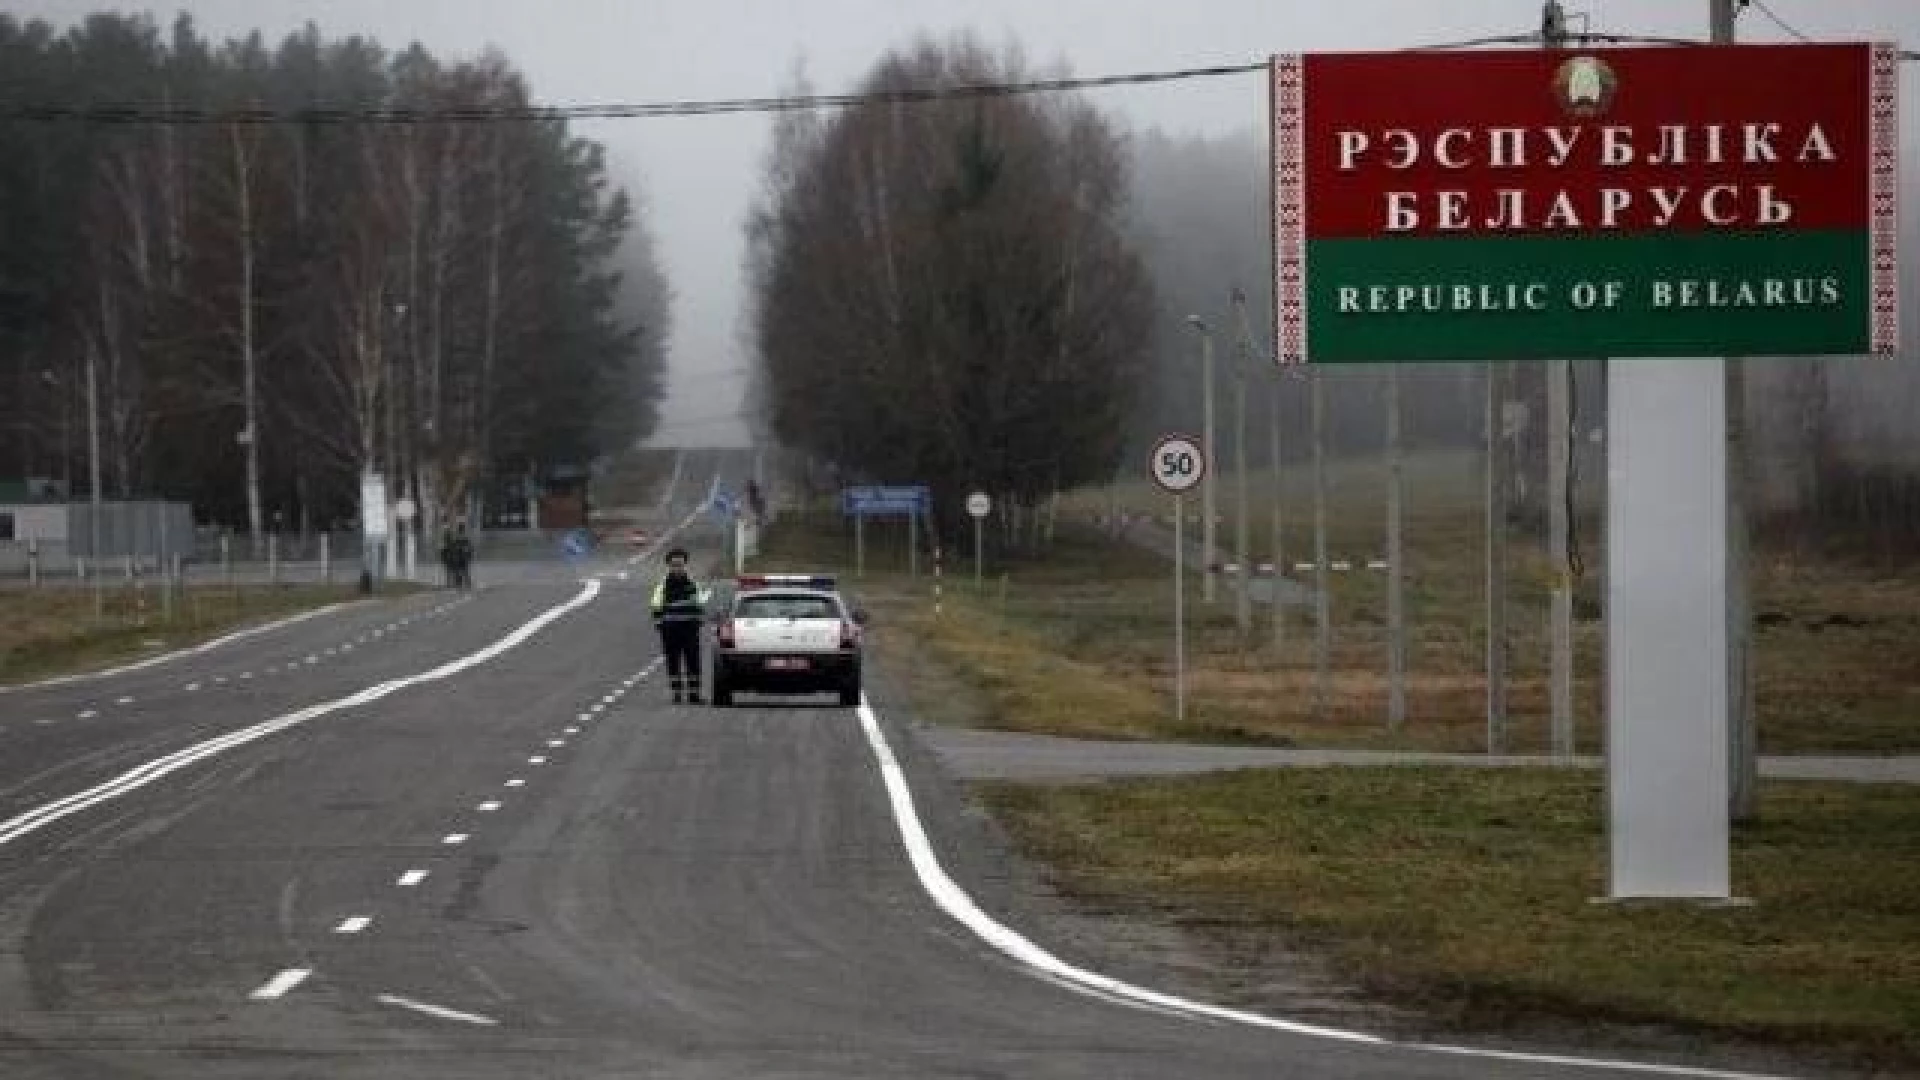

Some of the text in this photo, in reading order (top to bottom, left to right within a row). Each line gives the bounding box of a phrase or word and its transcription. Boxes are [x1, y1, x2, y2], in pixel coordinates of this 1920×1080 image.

[1337, 123, 1837, 169] РЭСПУБЛІКА
[1385, 185, 1793, 231] БЕЛАРУСЬ
[1338, 276, 1841, 313] REPUBLIC OF BELARUS
[1162, 452, 1193, 477] 50
